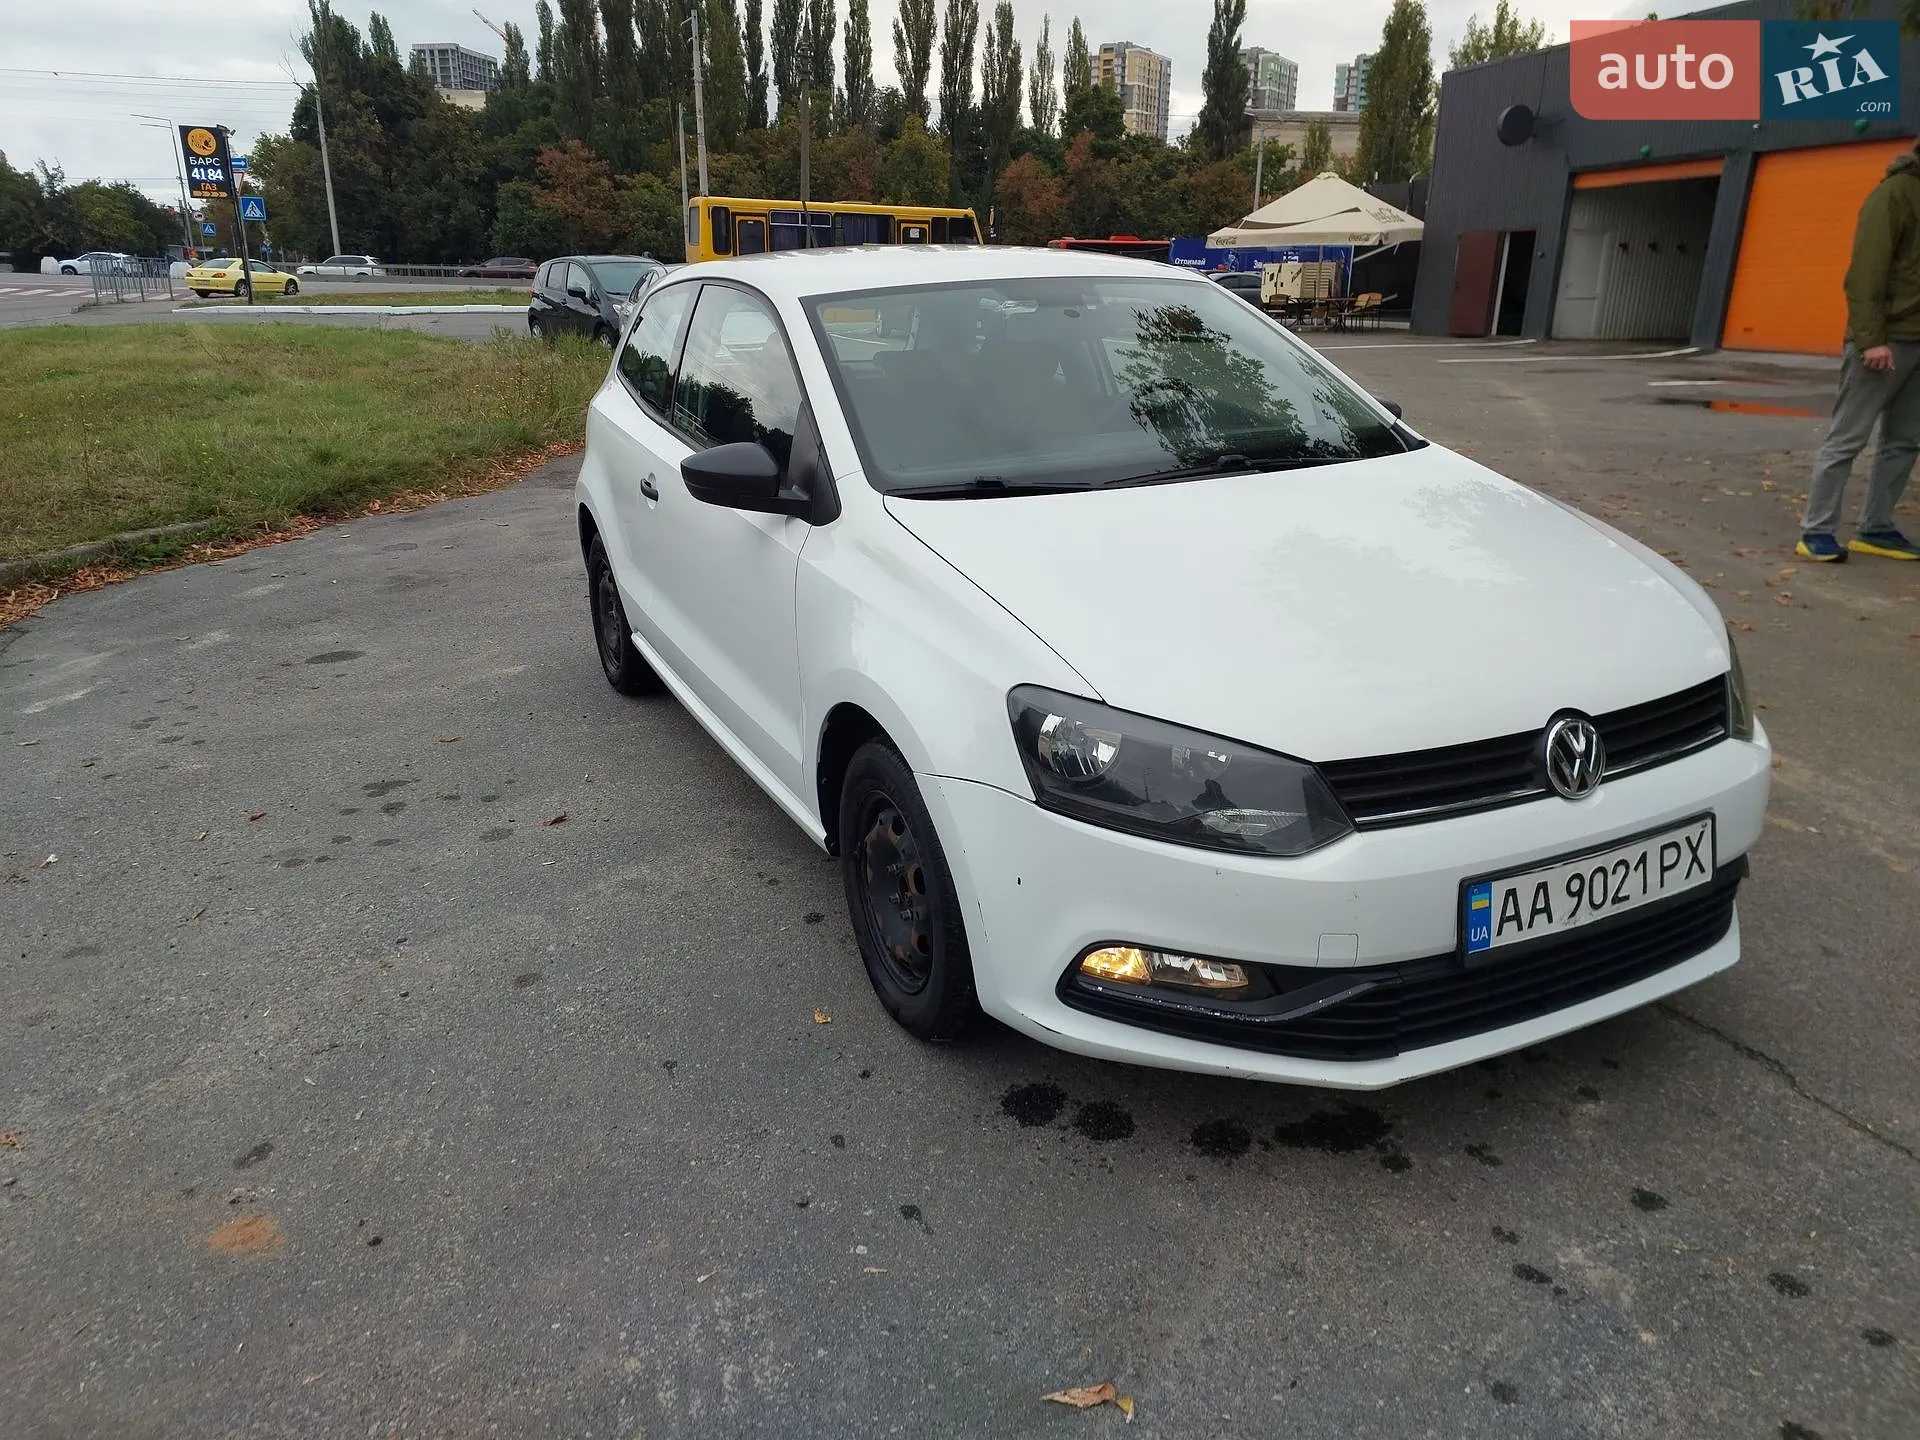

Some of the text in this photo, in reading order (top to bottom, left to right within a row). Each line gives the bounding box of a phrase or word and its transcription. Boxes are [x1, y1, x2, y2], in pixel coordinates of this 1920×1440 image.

[189, 156, 221, 167] БАРС
[201, 182, 217, 191] ГАЗ
[1174, 257, 1206, 267] Отримай
[1496, 830, 1706, 937] AA 9021 PX
[1470, 926, 1489, 943] UA
